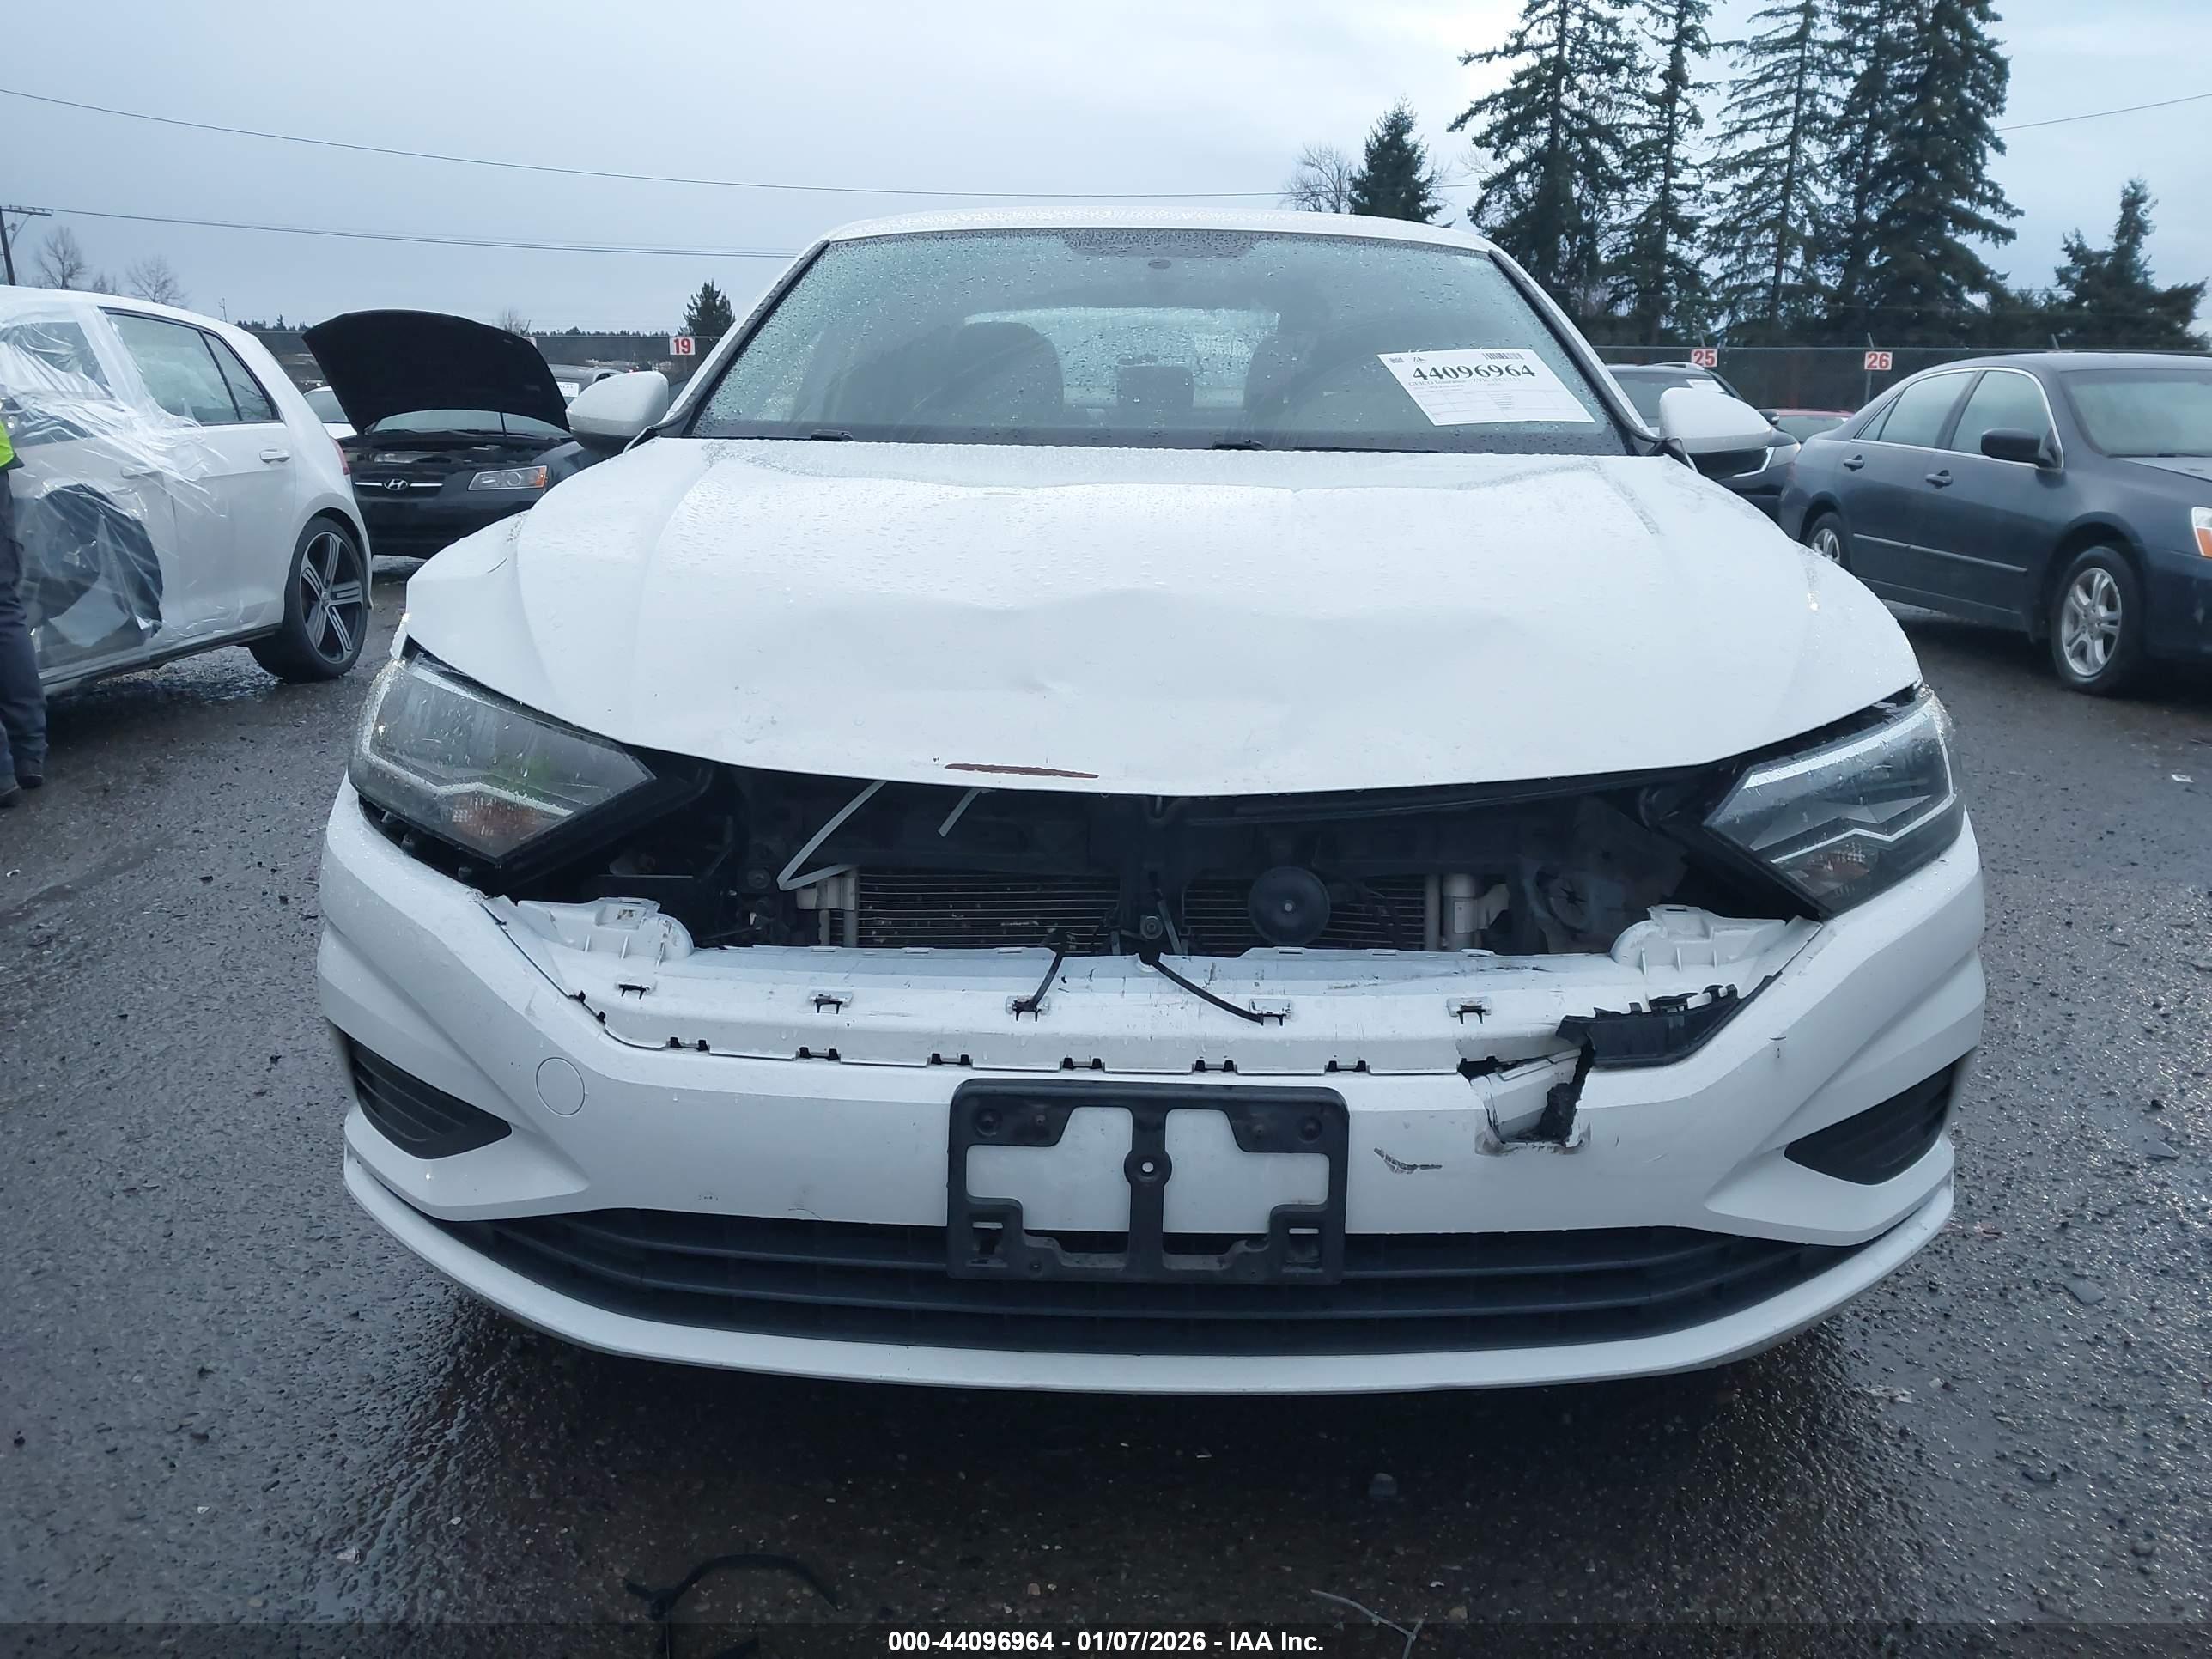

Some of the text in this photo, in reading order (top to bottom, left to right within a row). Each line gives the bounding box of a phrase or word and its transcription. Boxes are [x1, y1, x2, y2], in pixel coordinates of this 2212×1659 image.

[673, 338, 691, 354] 19
[1693, 350, 1716, 366] 25
[1867, 353, 1890, 369] 26
[1413, 363, 1536, 380] 44096964
